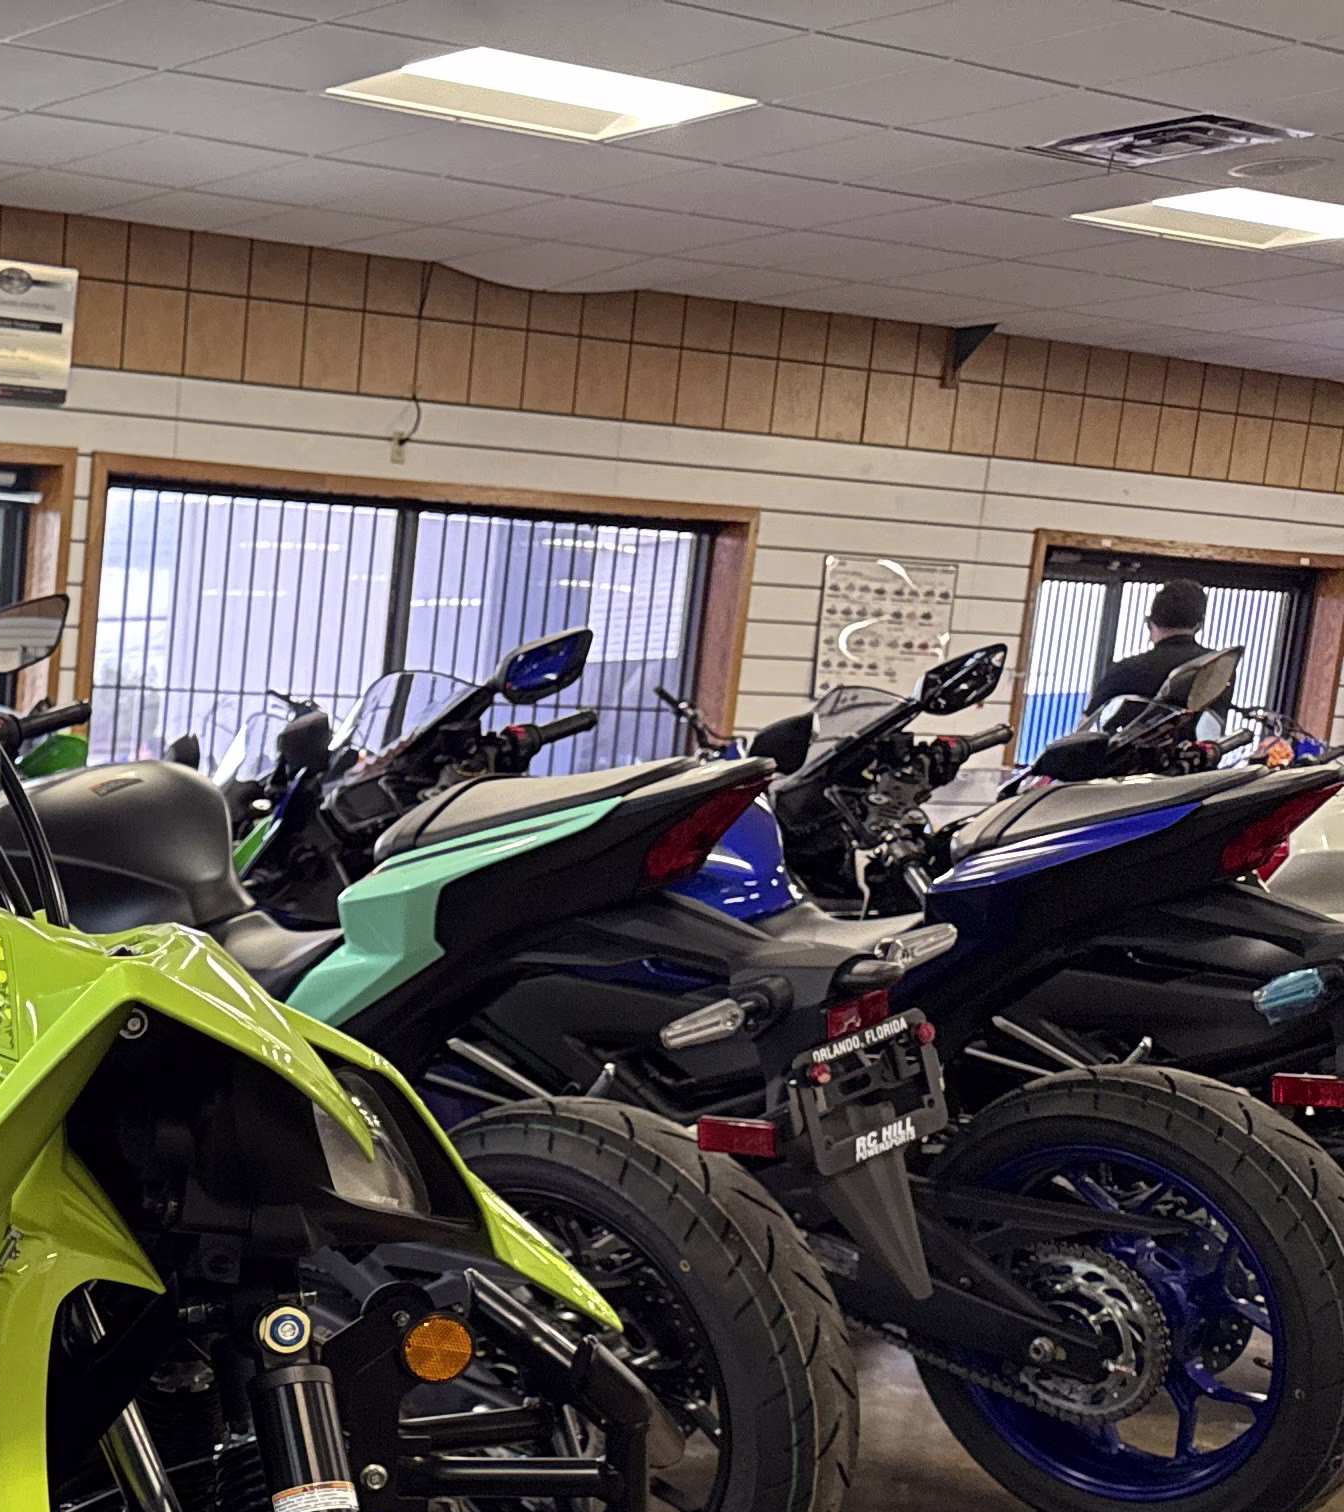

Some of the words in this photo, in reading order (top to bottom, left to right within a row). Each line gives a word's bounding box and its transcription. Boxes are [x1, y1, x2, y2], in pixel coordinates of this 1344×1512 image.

[865, 1017, 908, 1045] FLORIDA
[856, 1130, 878, 1153] RC
[882, 1116, 915, 1140] HILL
